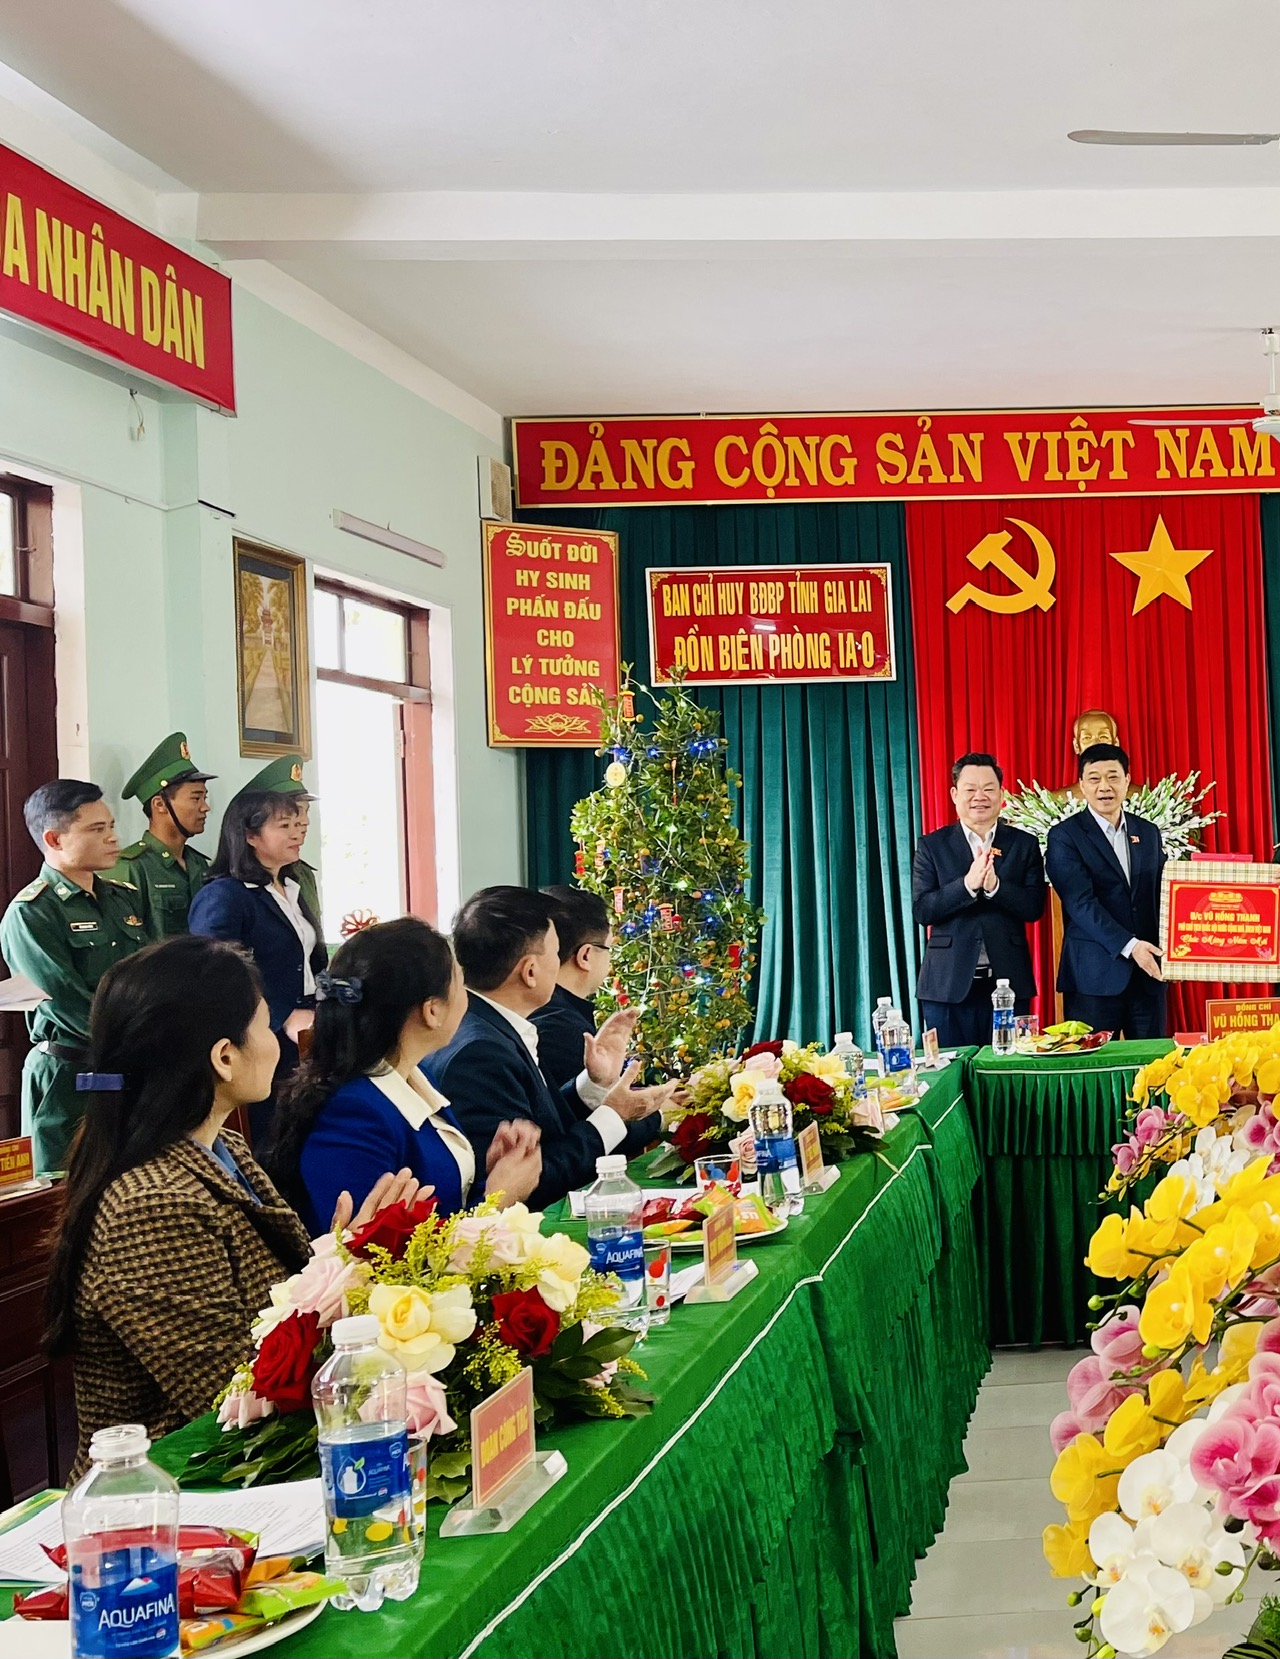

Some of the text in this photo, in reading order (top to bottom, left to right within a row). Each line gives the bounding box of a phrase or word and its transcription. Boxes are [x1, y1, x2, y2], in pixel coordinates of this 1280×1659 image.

[1, 192, 205, 369] A NHÂN DÂN
[541, 422, 695, 492] ĐẢNG
[715, 421, 858, 499] CỘNG
[875, 416, 984, 485] SẢN
[1004, 416, 1135, 492] VIỆT
[1153, 427, 1276, 479] NAM
[505, 532, 598, 563] SUỐT ĐỜI
[516, 570, 591, 591] HY SINH
[662, 571, 872, 617] BAN CHỈ HUY BĐBP TỈNH GIA LAI
[506, 594, 601, 620] PHẤN ĐẤU
[536, 629, 575, 648] CHO
[674, 624, 875, 672] ĐỒN BIÊN PHÒNG IA O
[511, 654, 600, 677] LÝ TƯỞNG
[508, 683, 561, 708] CỘNG
[1213, 1013, 1226, 1028] VŨ
[98, 1593, 175, 1631] AQUAFINA
